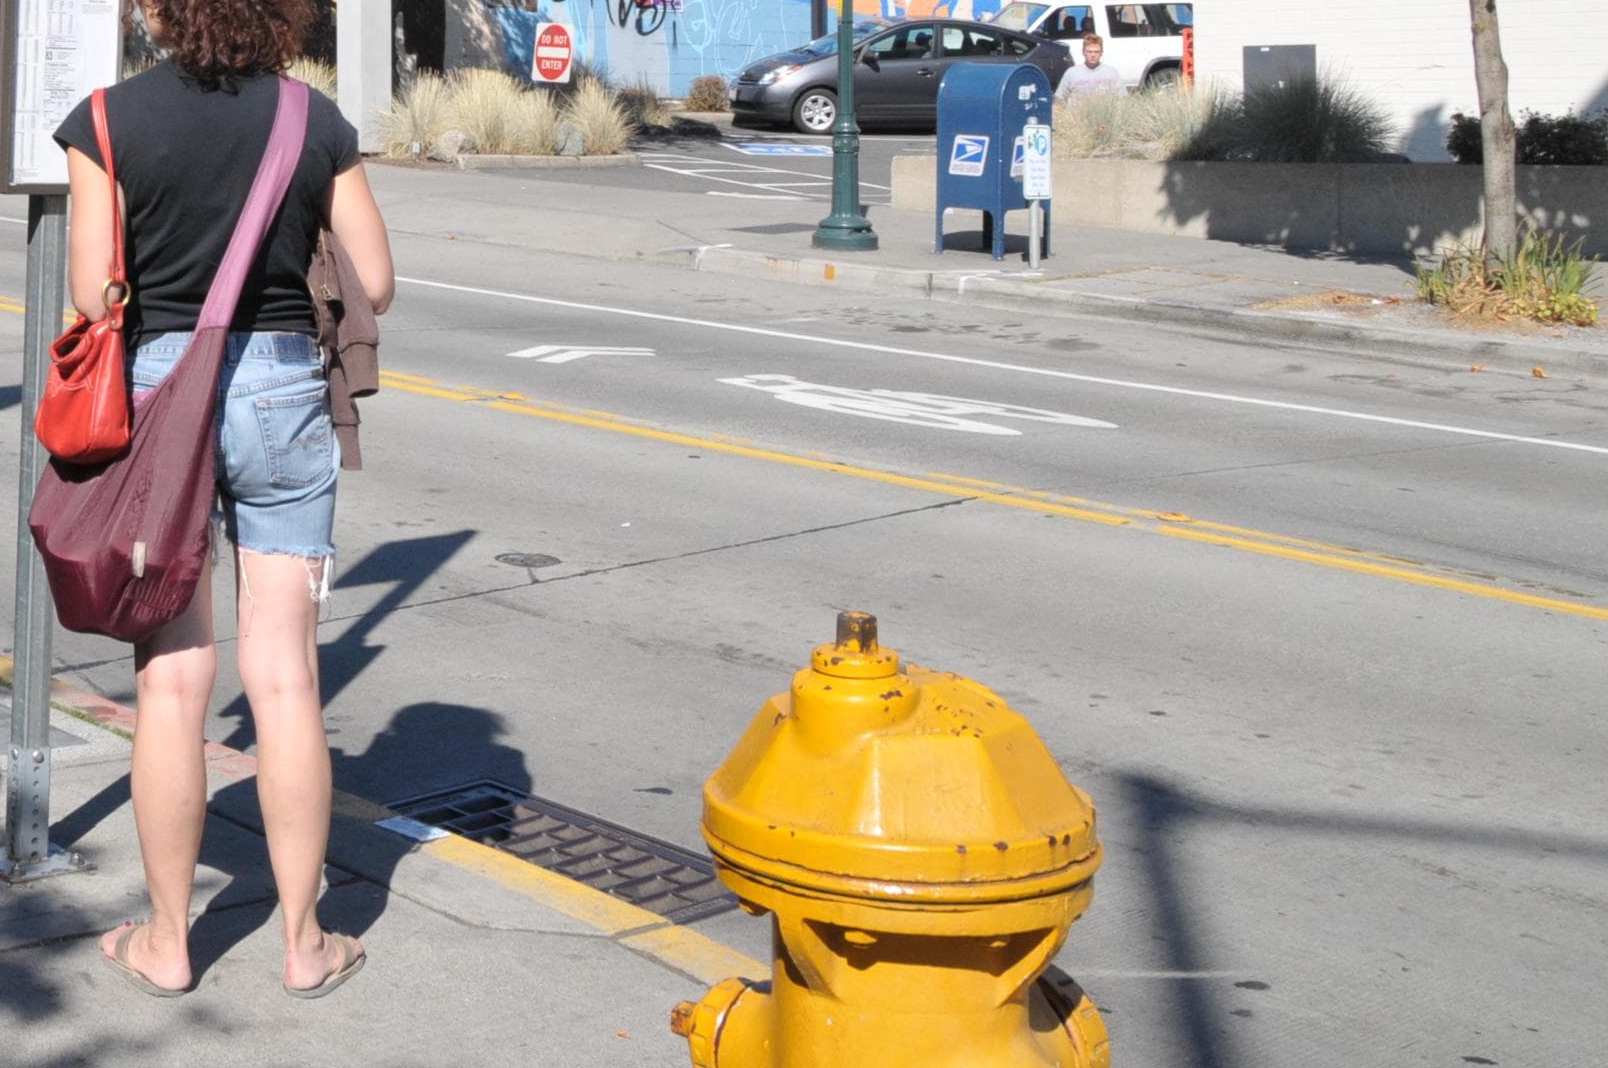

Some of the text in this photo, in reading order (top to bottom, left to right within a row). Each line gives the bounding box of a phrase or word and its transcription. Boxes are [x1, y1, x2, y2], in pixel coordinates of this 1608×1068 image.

[541, 34, 567, 45] DO NOT
[541, 59, 562, 70] ENTER
